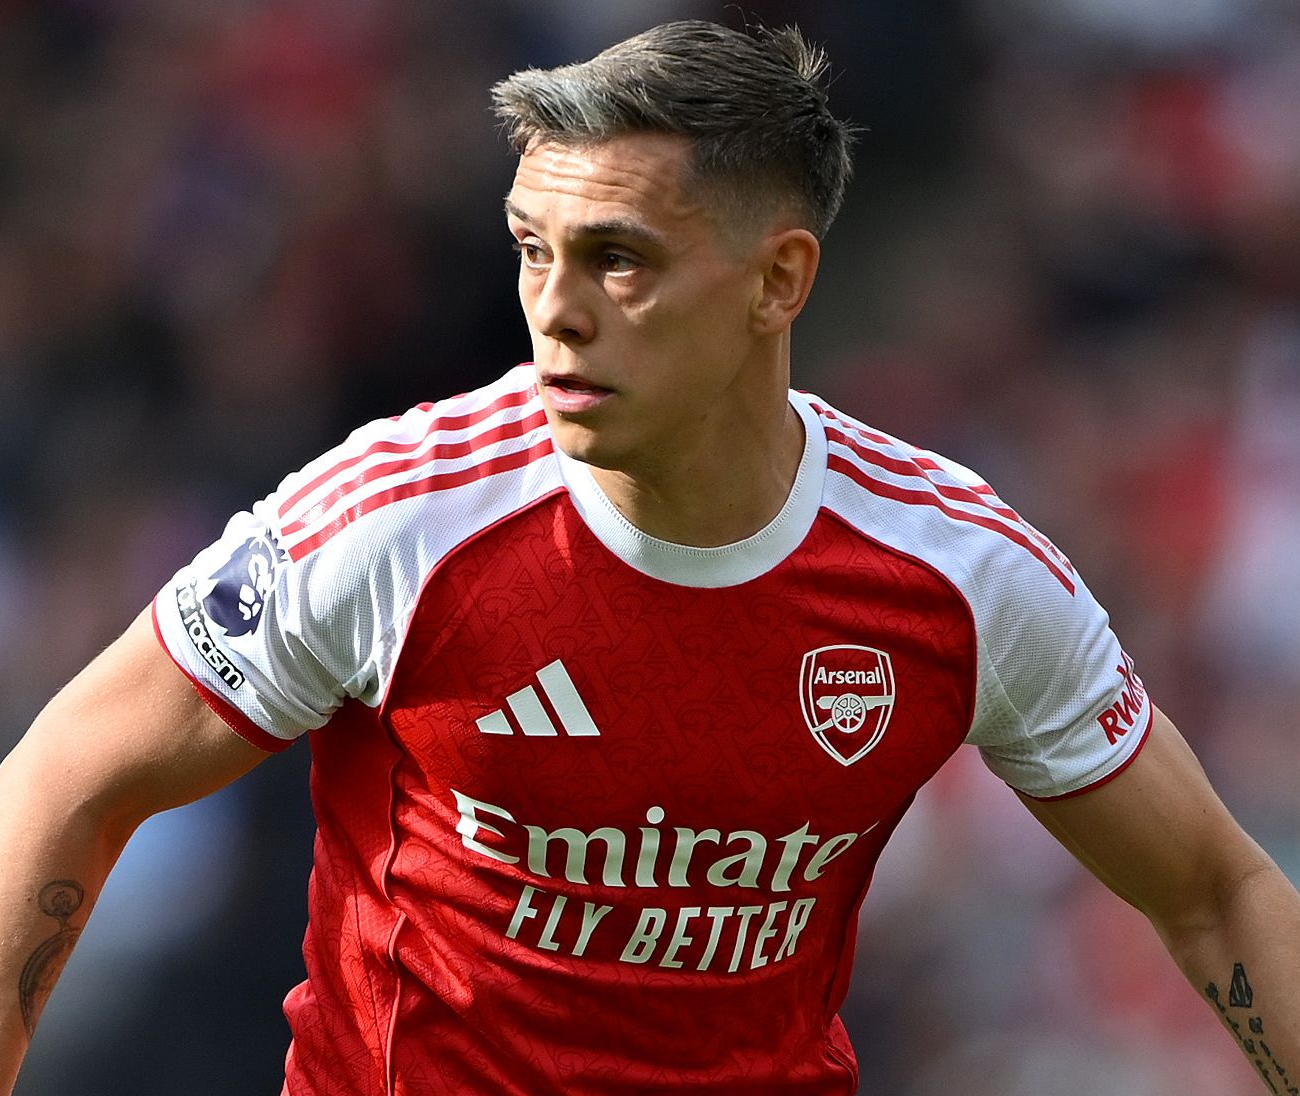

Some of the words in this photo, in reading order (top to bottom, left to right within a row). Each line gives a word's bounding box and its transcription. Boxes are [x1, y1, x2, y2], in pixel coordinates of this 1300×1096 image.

[184, 611, 244, 690] racism
[813, 666, 882, 686] Arsenal
[450, 788, 880, 892] Emirate
[505, 885, 613, 957] FLY
[620, 897, 817, 973] BETTER
